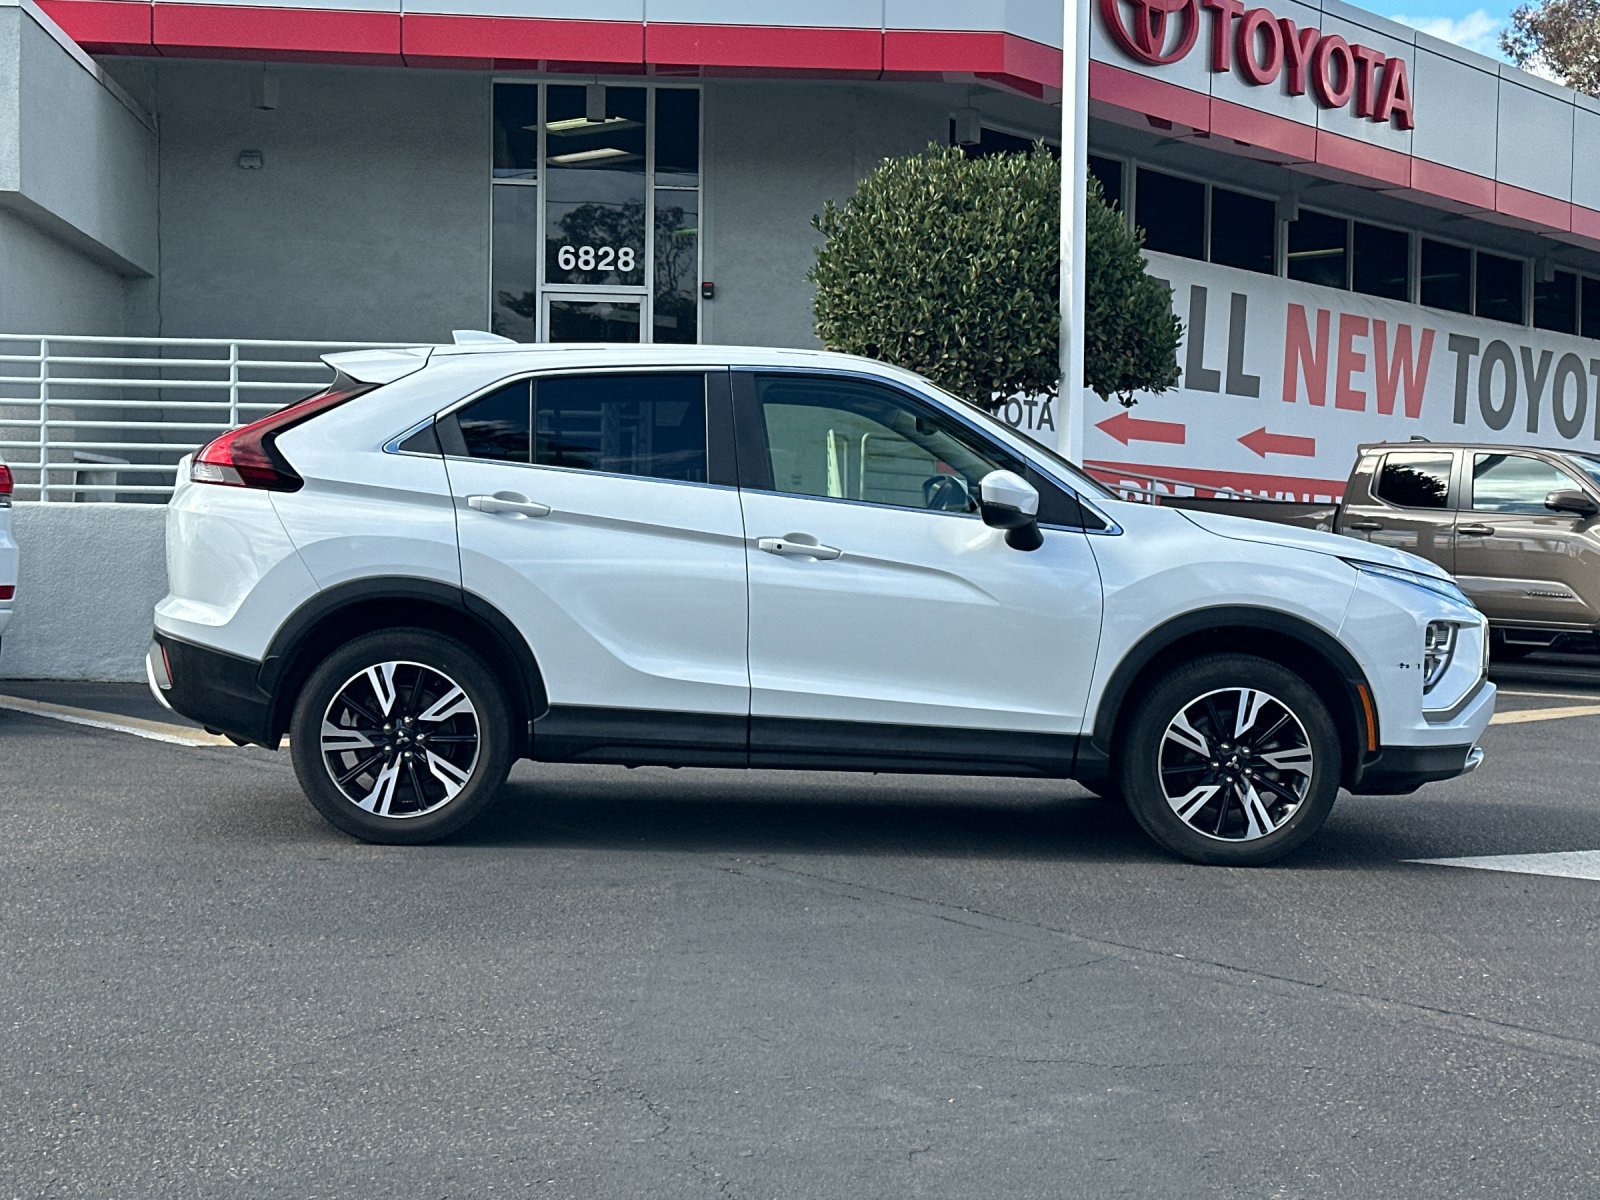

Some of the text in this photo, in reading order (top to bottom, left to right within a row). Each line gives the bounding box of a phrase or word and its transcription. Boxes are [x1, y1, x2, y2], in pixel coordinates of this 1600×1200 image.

[1202, 0, 1415, 130] TOYOTA
[557, 245, 636, 272] 6828
[1282, 303, 1436, 419] NEW
